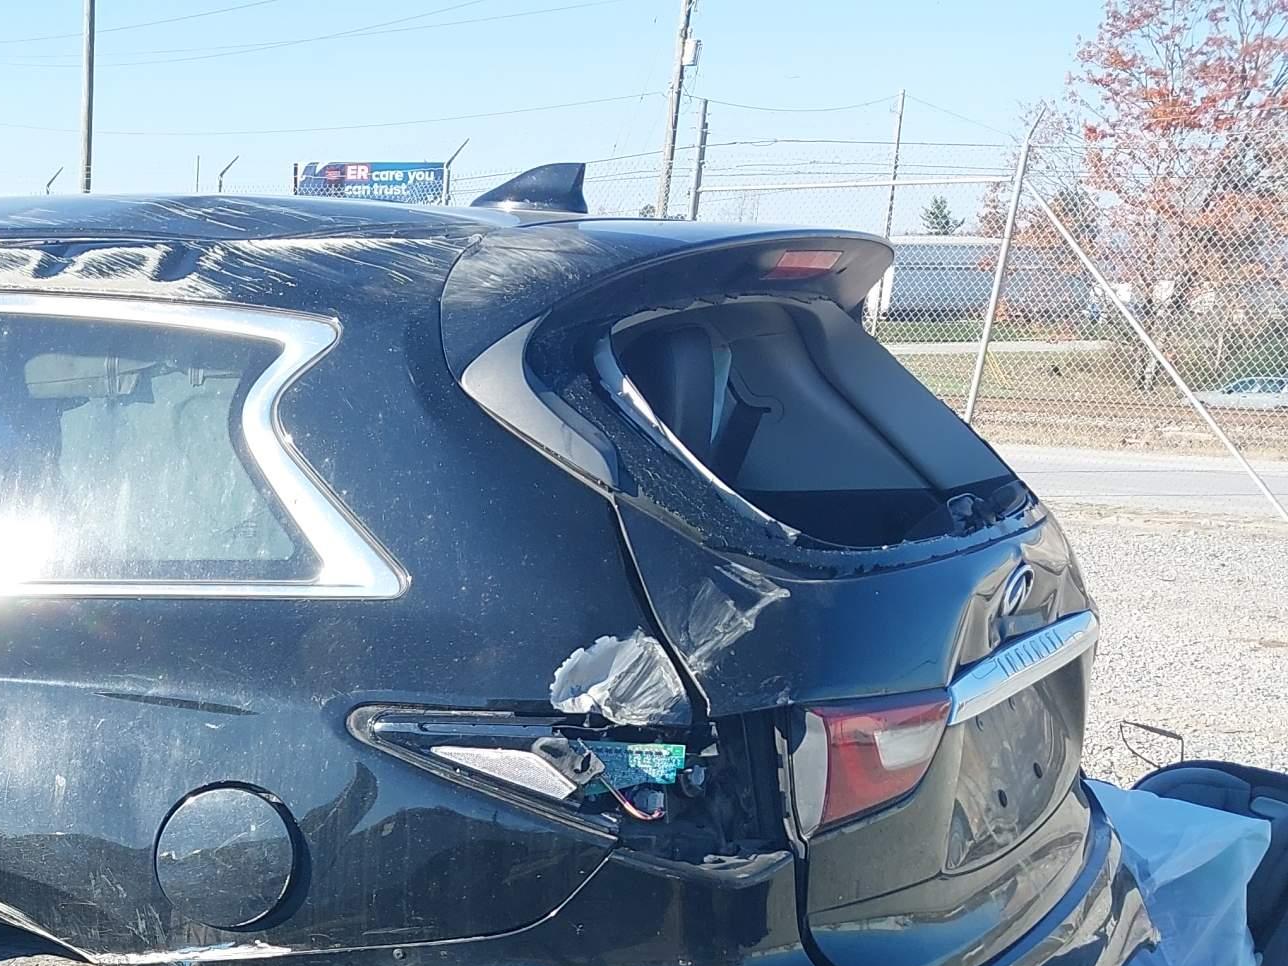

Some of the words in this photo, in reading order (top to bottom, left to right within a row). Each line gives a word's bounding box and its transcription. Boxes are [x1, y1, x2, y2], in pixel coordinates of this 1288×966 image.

[346, 165, 369, 180] ER
[372, 170, 404, 181] care
[407, 170, 434, 184] you
[344, 184, 371, 195] can
